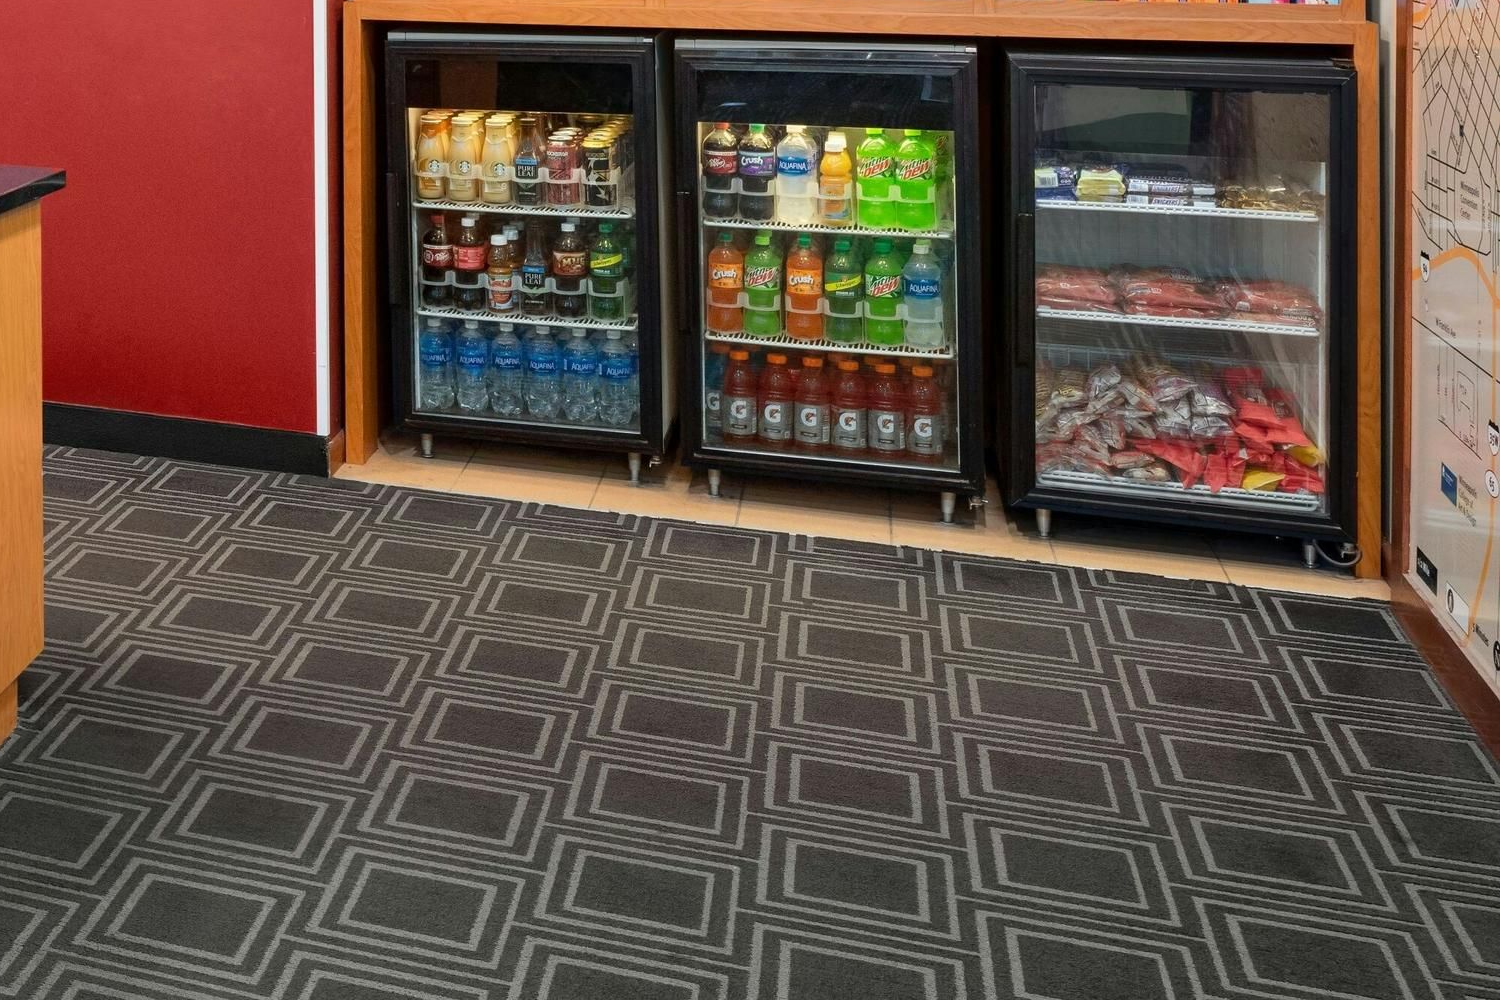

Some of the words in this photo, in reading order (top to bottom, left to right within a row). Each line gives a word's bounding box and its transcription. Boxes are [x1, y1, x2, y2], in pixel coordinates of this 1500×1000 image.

[741, 155, 763, 166] Crush
[779, 160, 807, 173] AQUAFINA
[712, 268, 738, 280] Crush
[789, 275, 814, 286] Crush
[909, 283, 939, 294] AQUAFINA
[529, 360, 556, 371] AQUAFINA
[571, 361, 595, 372] AQUAFI
[606, 367, 631, 378] AQUAFIN
[706, 392, 720, 411] G
[730, 400, 747, 419] G
[764, 404, 781, 423] G
[800, 407, 817, 427] G
[839, 412, 857, 431] G
[877, 414, 895, 434] G
[914, 418, 933, 438] G
